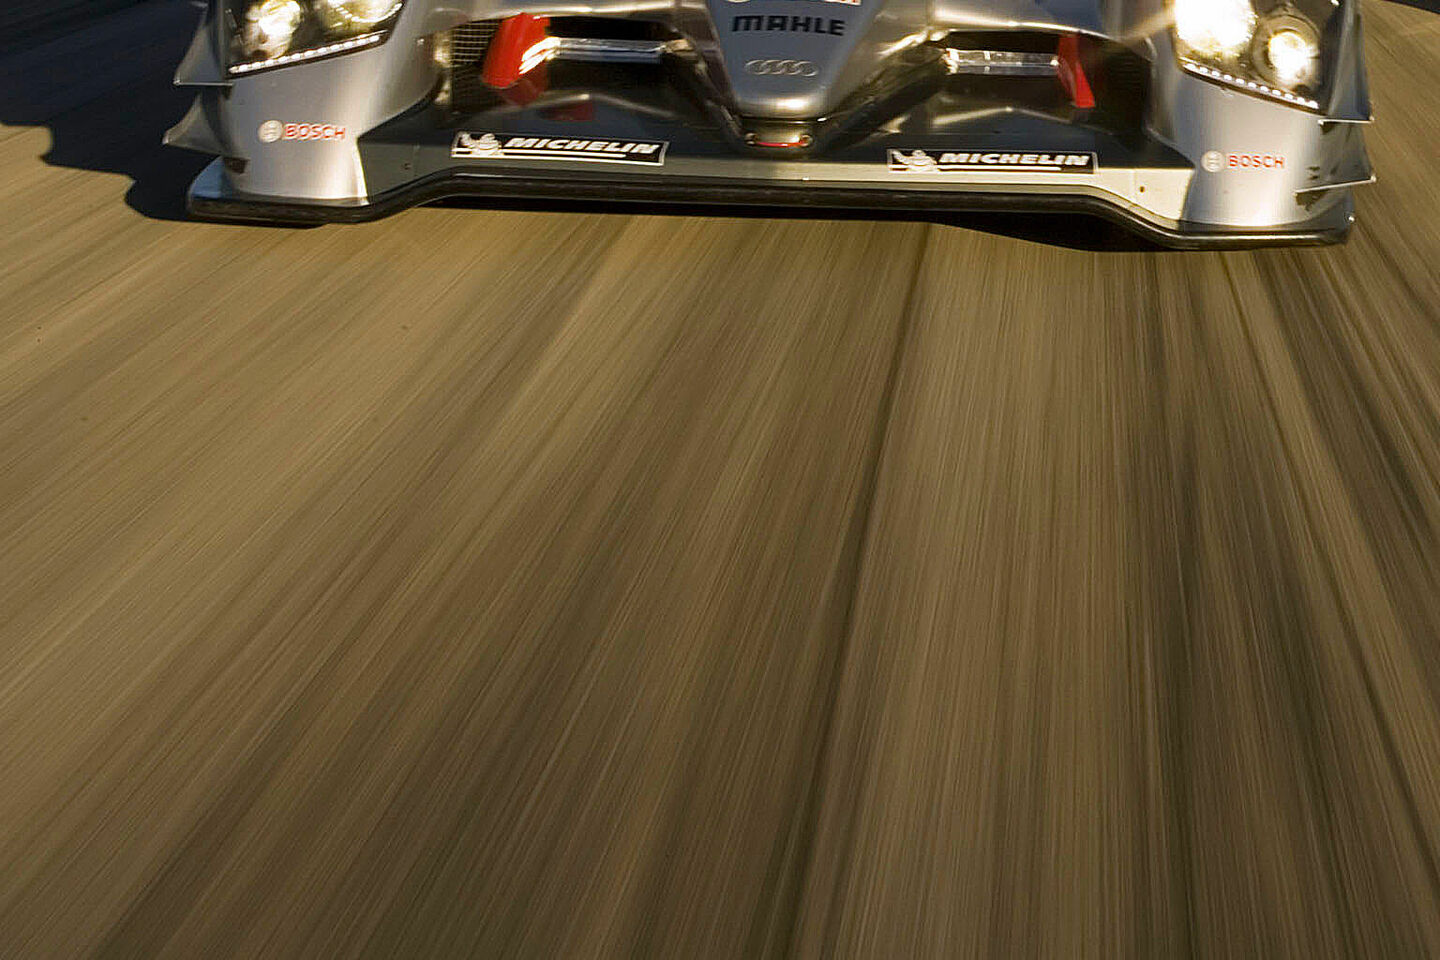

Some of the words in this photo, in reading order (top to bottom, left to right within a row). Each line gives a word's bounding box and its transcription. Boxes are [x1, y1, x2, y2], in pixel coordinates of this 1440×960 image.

[731, 14, 846, 36] MAHLE
[283, 123, 346, 140] BOSCH
[502, 136, 660, 154] MICHELIN
[939, 152, 1090, 166] MICHELIN
[1228, 154, 1285, 169] BOSCH
